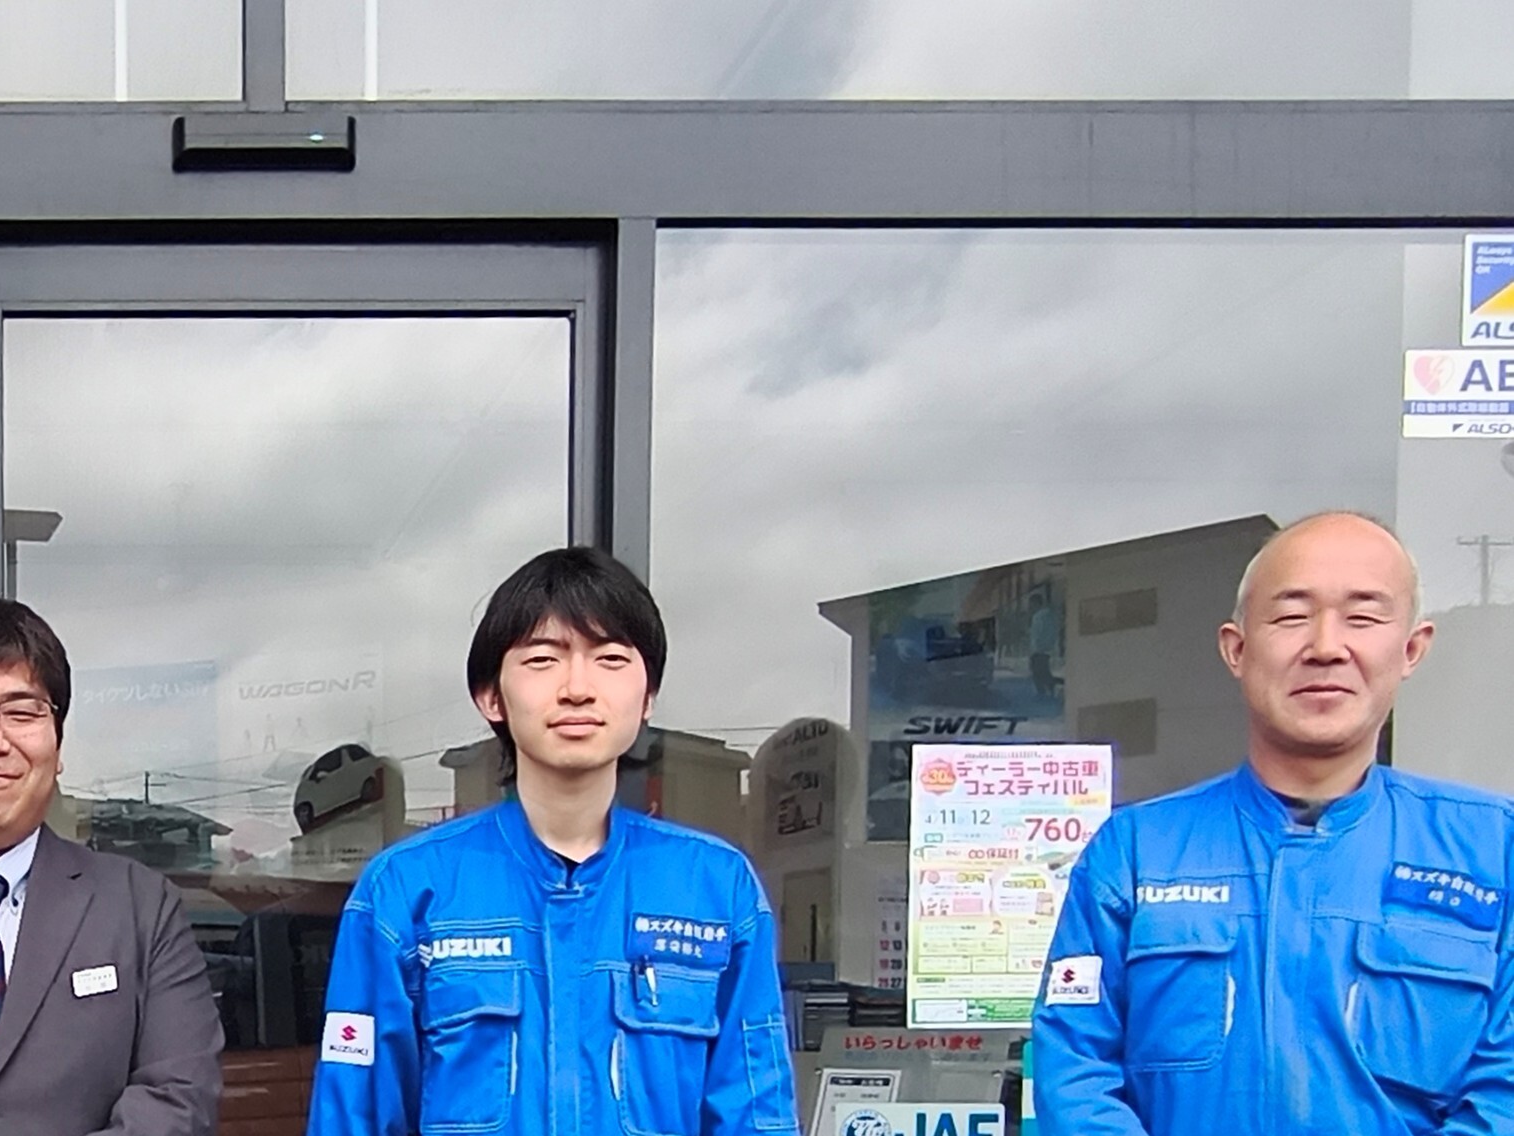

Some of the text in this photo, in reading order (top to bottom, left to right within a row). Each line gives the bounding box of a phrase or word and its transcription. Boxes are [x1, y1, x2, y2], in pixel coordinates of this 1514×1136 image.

[1467, 422, 1514, 434] ALSO
[904, 714, 1027, 736] SWIFT
[957, 760, 1099, 778] ディーラー中古車
[964, 780, 1088, 796] フェスティバル
[844, 1034, 983, 1051] いらっしゃいませ
